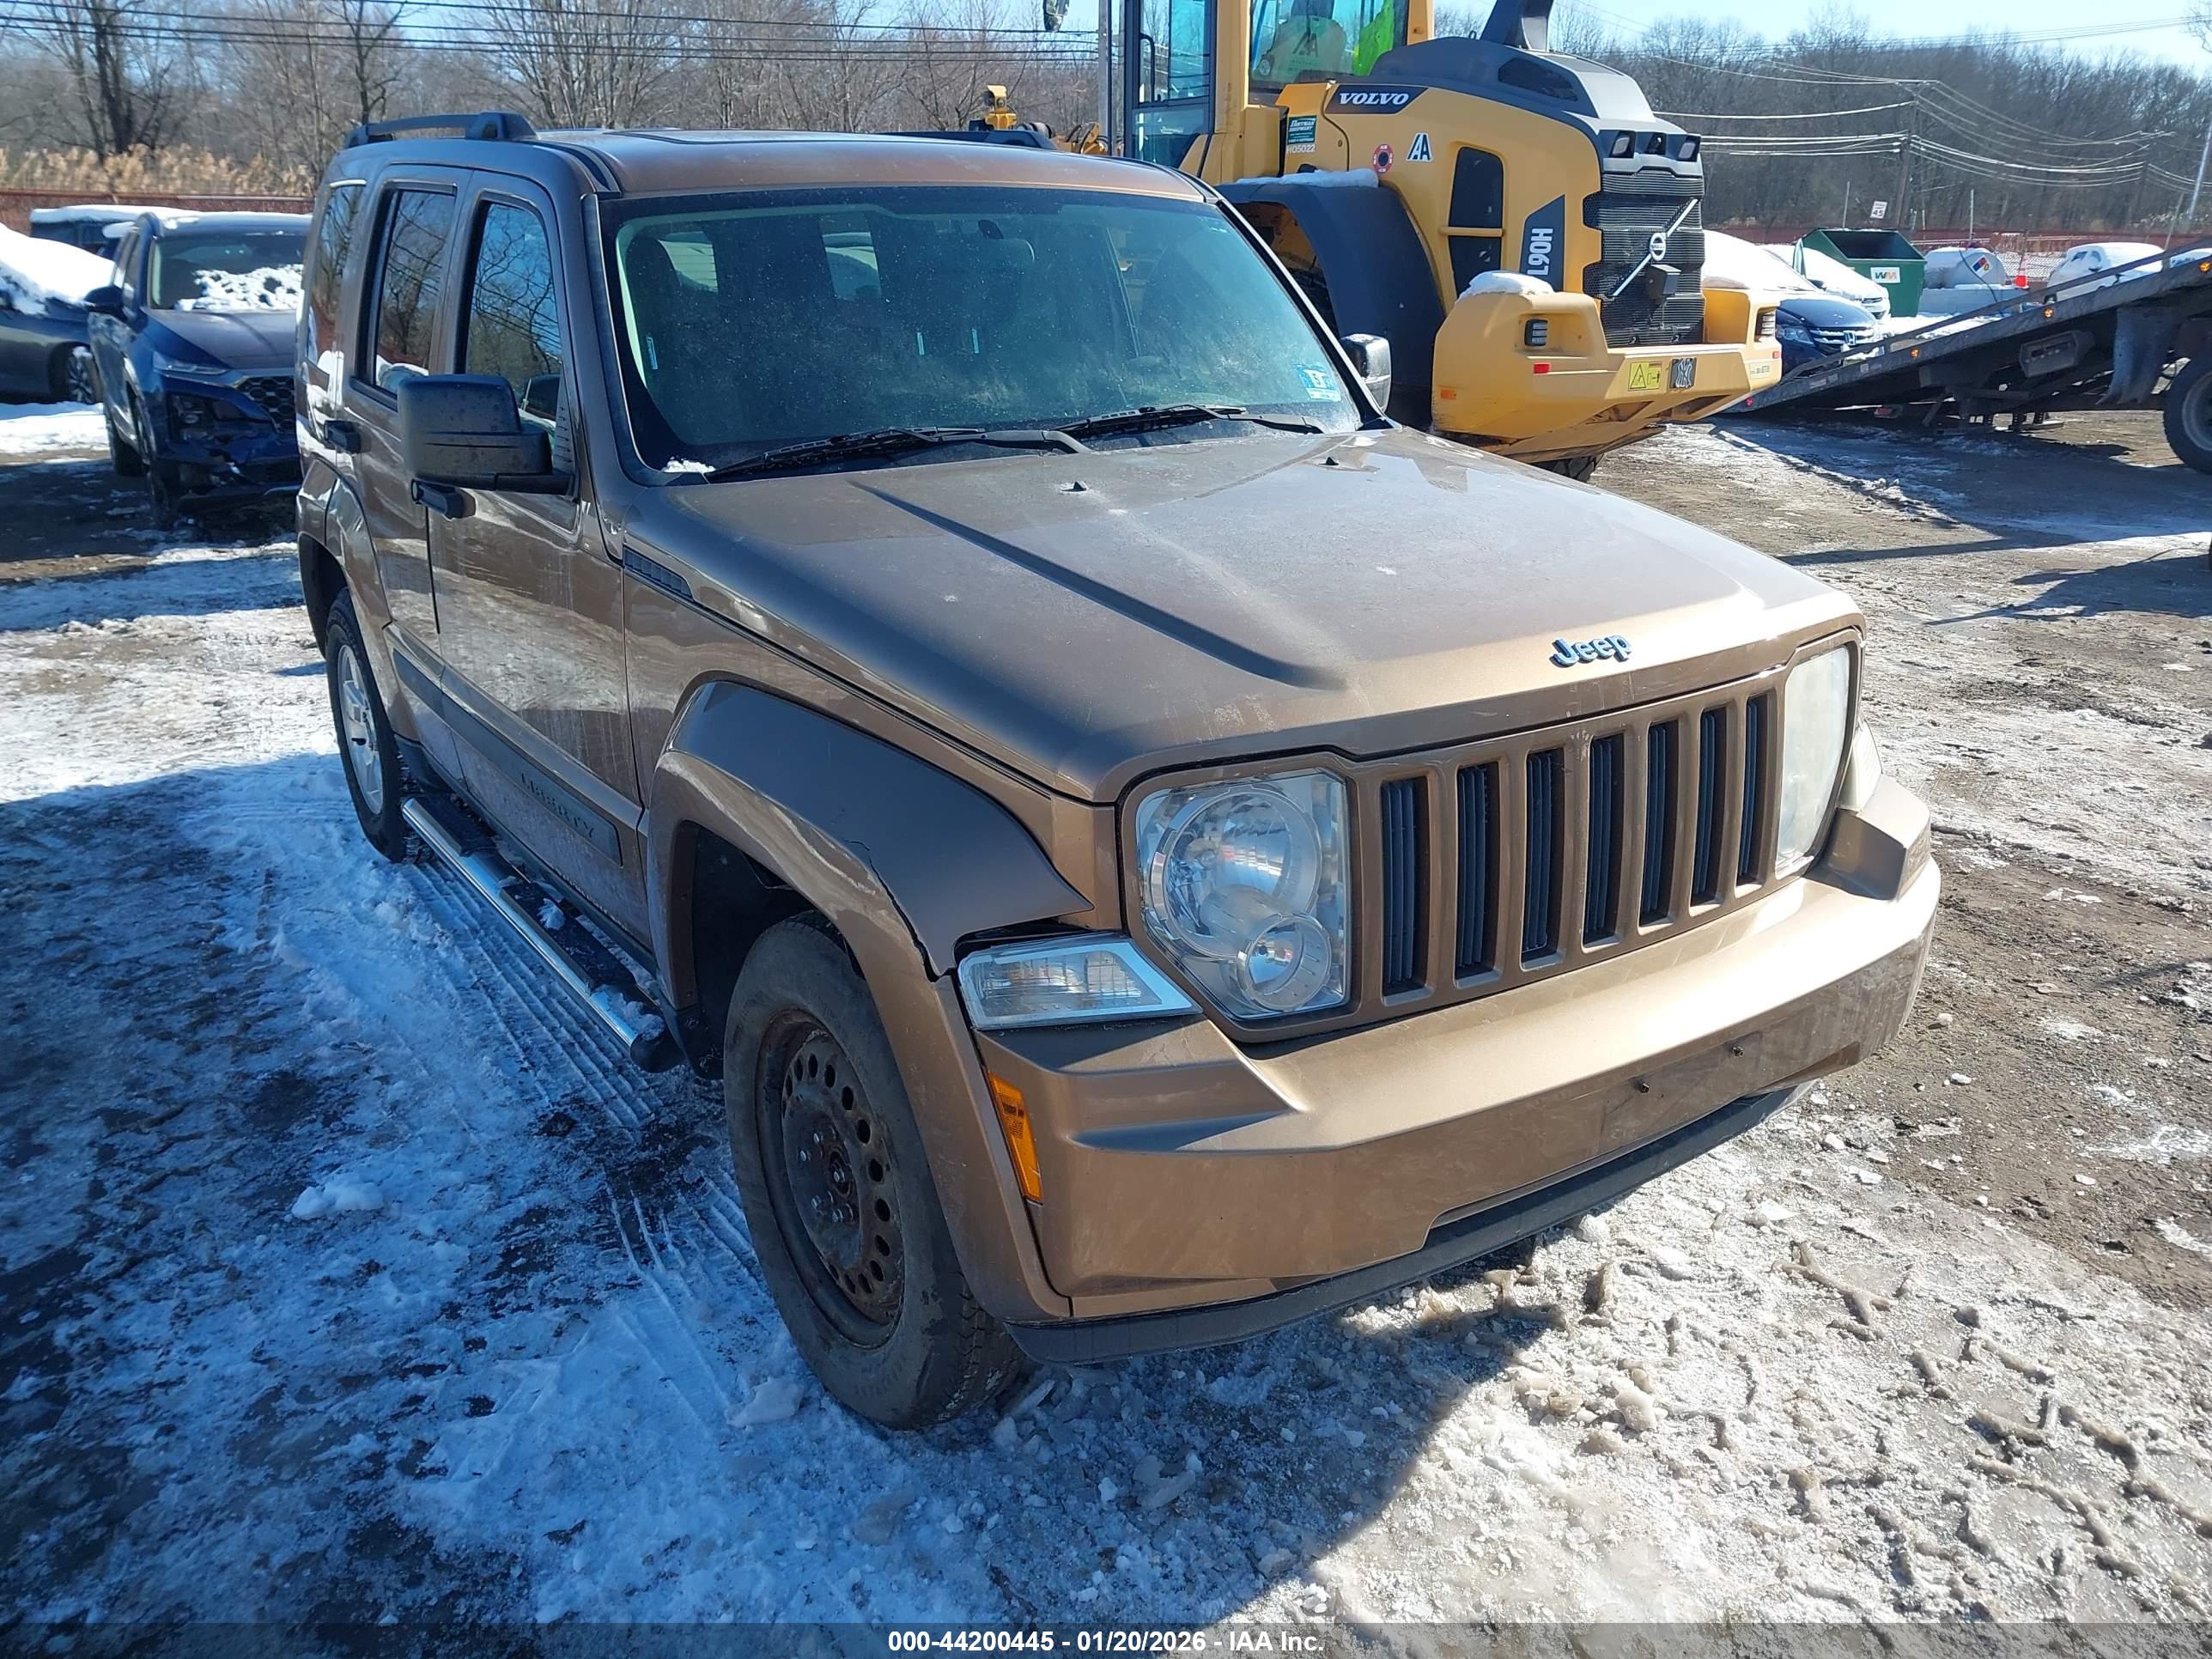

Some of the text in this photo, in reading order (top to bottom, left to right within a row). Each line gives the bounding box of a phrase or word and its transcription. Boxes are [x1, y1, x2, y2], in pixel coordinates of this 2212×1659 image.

[1339, 92, 1409, 106] VOLVO
[1527, 228, 1553, 276] L90H
[1549, 635, 1632, 668] Jeep
